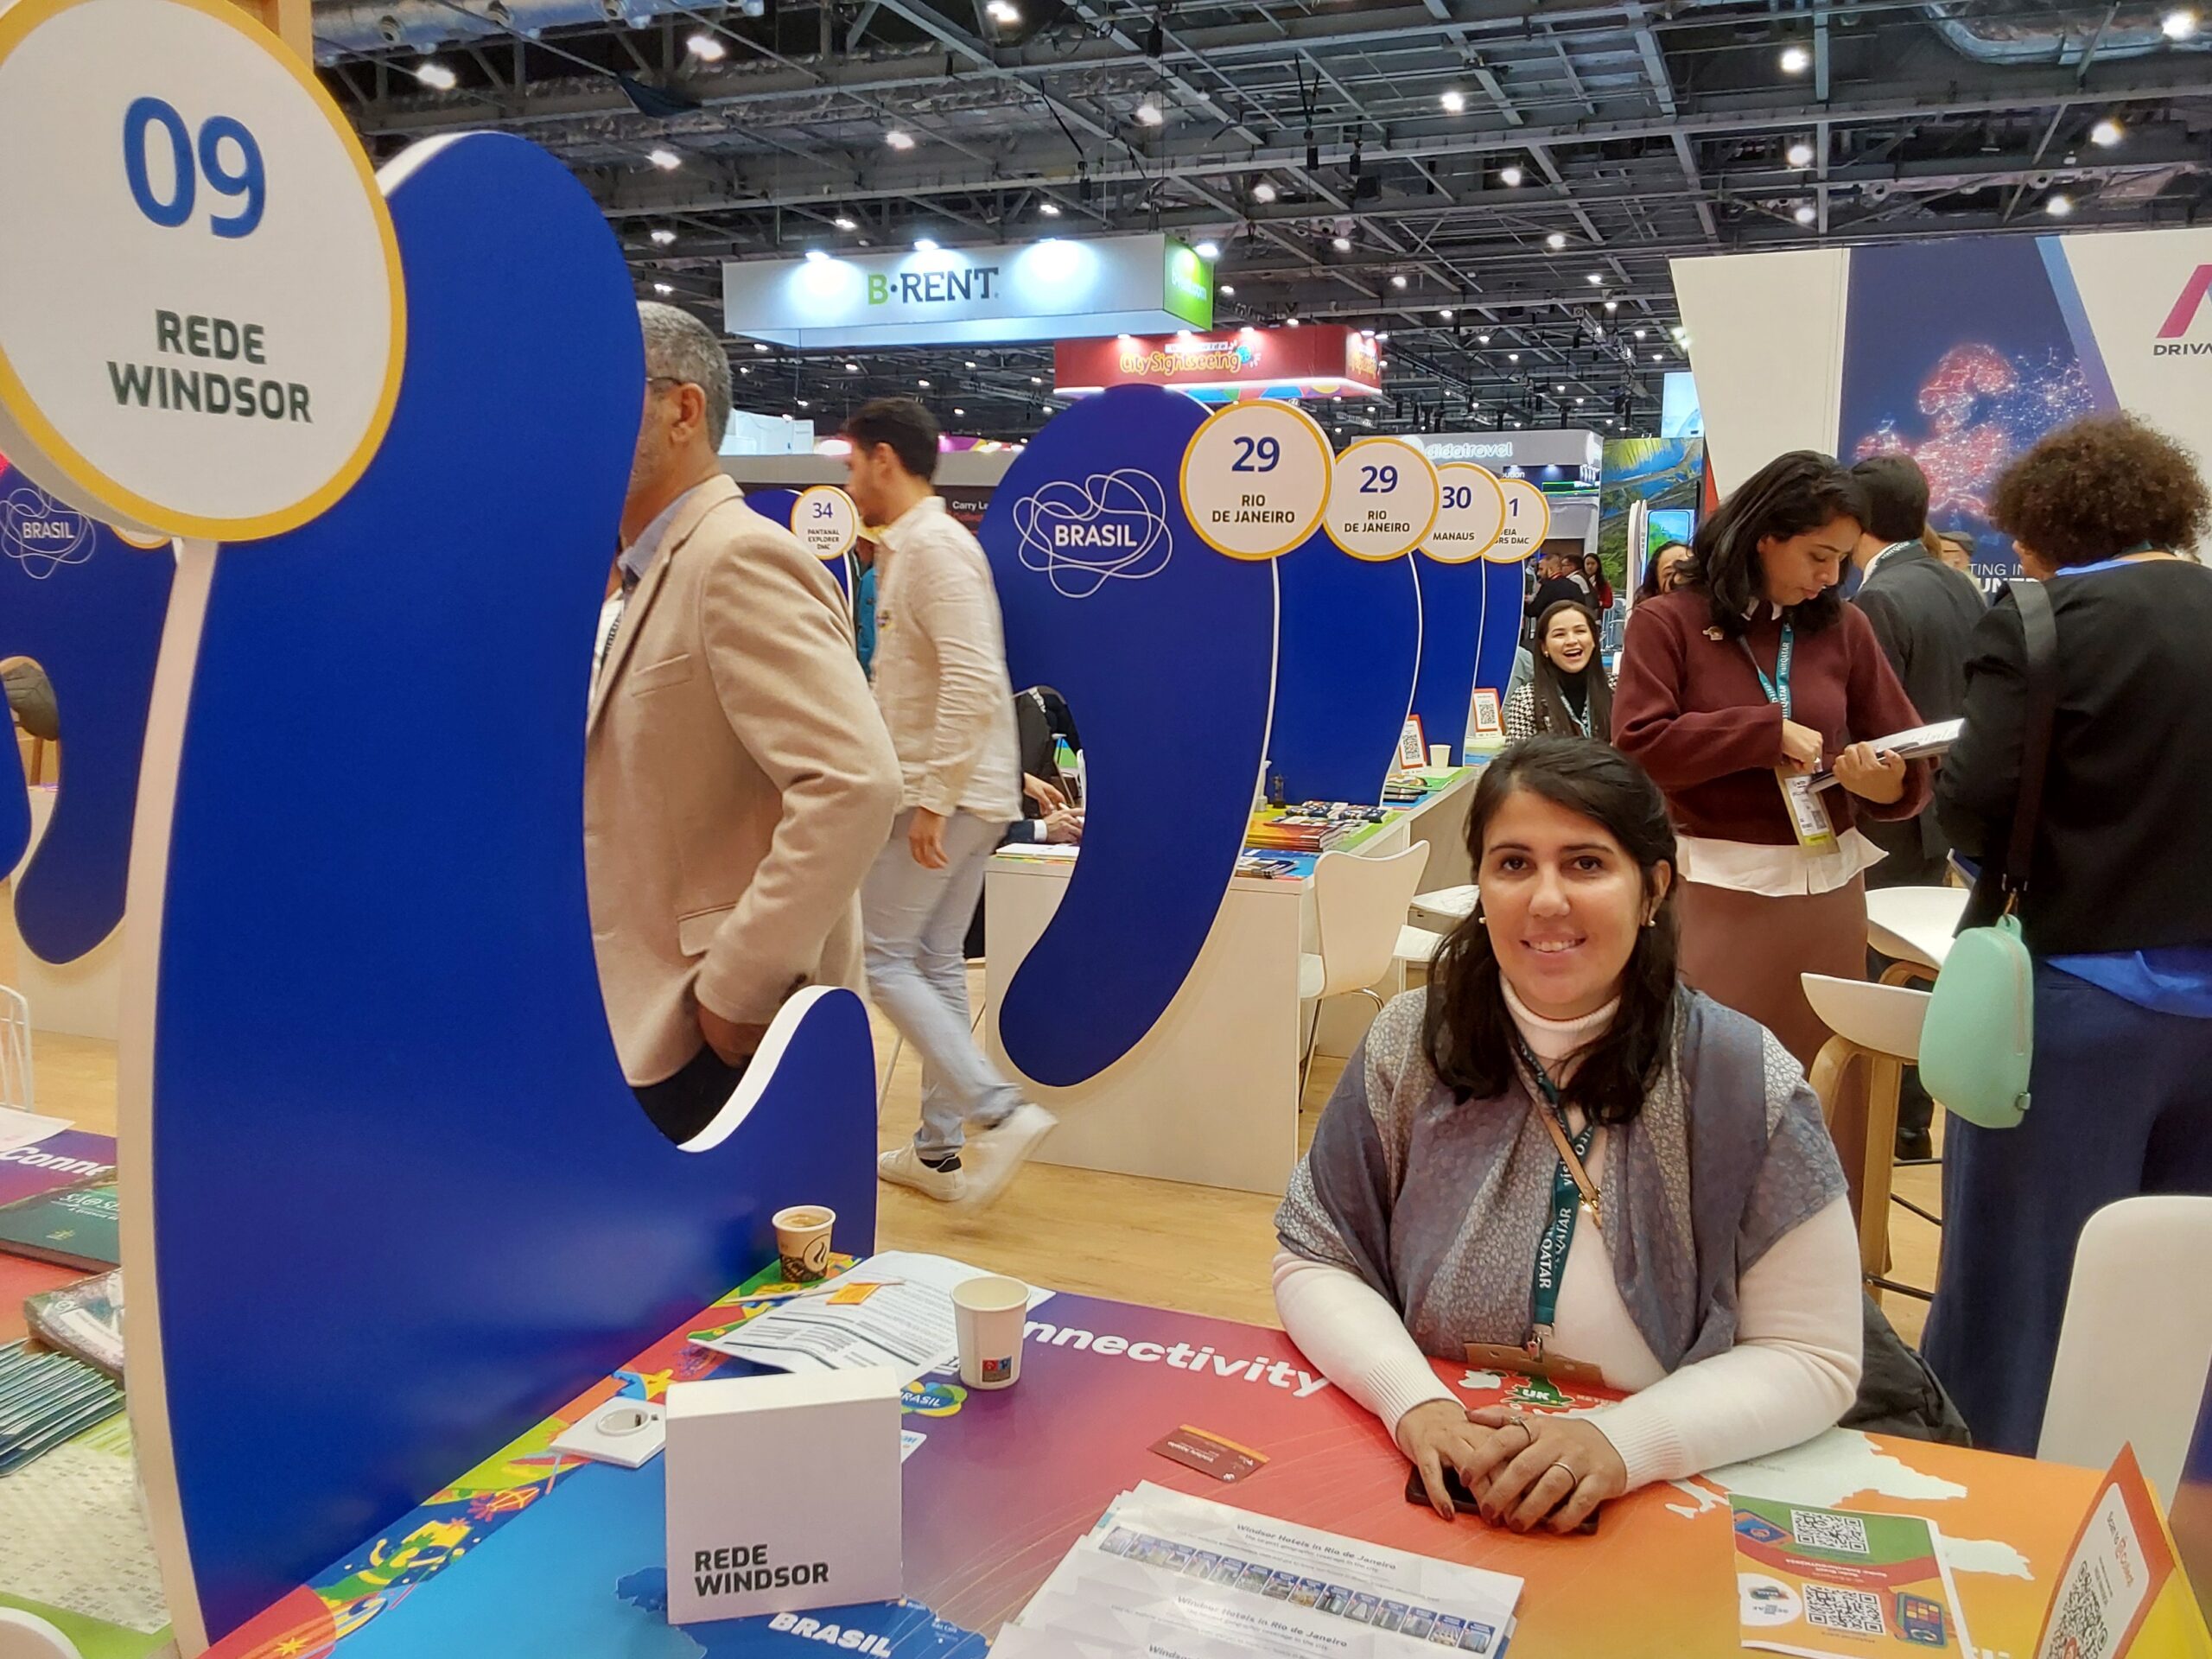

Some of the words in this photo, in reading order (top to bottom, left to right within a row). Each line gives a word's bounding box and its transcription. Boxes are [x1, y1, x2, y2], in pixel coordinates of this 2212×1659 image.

[123, 96, 266, 239] 09
[156, 308, 267, 365] REDE
[105, 360, 314, 423] WINDSOR
[1231, 435, 1281, 473] 29
[1359, 465, 1399, 493] 29
[811, 501, 834, 519] 34
[1241, 494, 1266, 507] RIO
[1442, 486, 1472, 510] 30
[1211, 510, 1230, 524] DE
[1234, 510, 1295, 524] JANEIRO
[1344, 522, 1359, 533] DE
[1362, 521, 1411, 534] JANEIRO
[1367, 510, 1388, 521] RIO
[22, 521, 75, 539] BRASIL
[1054, 524, 1138, 547] BRASIL
[1432, 531, 1476, 542] MANAUS
[1968, 563, 2007, 576] TING
[1022, 1320, 1331, 1397] nnectivity
[1522, 1389, 1550, 1401] UK
[694, 1544, 768, 1572] REDE
[1236, 1523, 1276, 1539] Windsor
[1278, 1534, 1310, 1548] Hotels
[1313, 1542, 1322, 1552] in
[1324, 1546, 1341, 1555] Rio
[1343, 1550, 1355, 1559] de
[1358, 1555, 1396, 1570] Janeiro
[695, 1561, 830, 1598] WINDSOR
[768, 1611, 892, 1659] BRASIL
[1257, 1617, 1268, 1626] in
[1270, 1621, 1288, 1631] Rio
[1290, 1626, 1303, 1636] de
[1306, 1631, 1348, 1648] Janeiro
